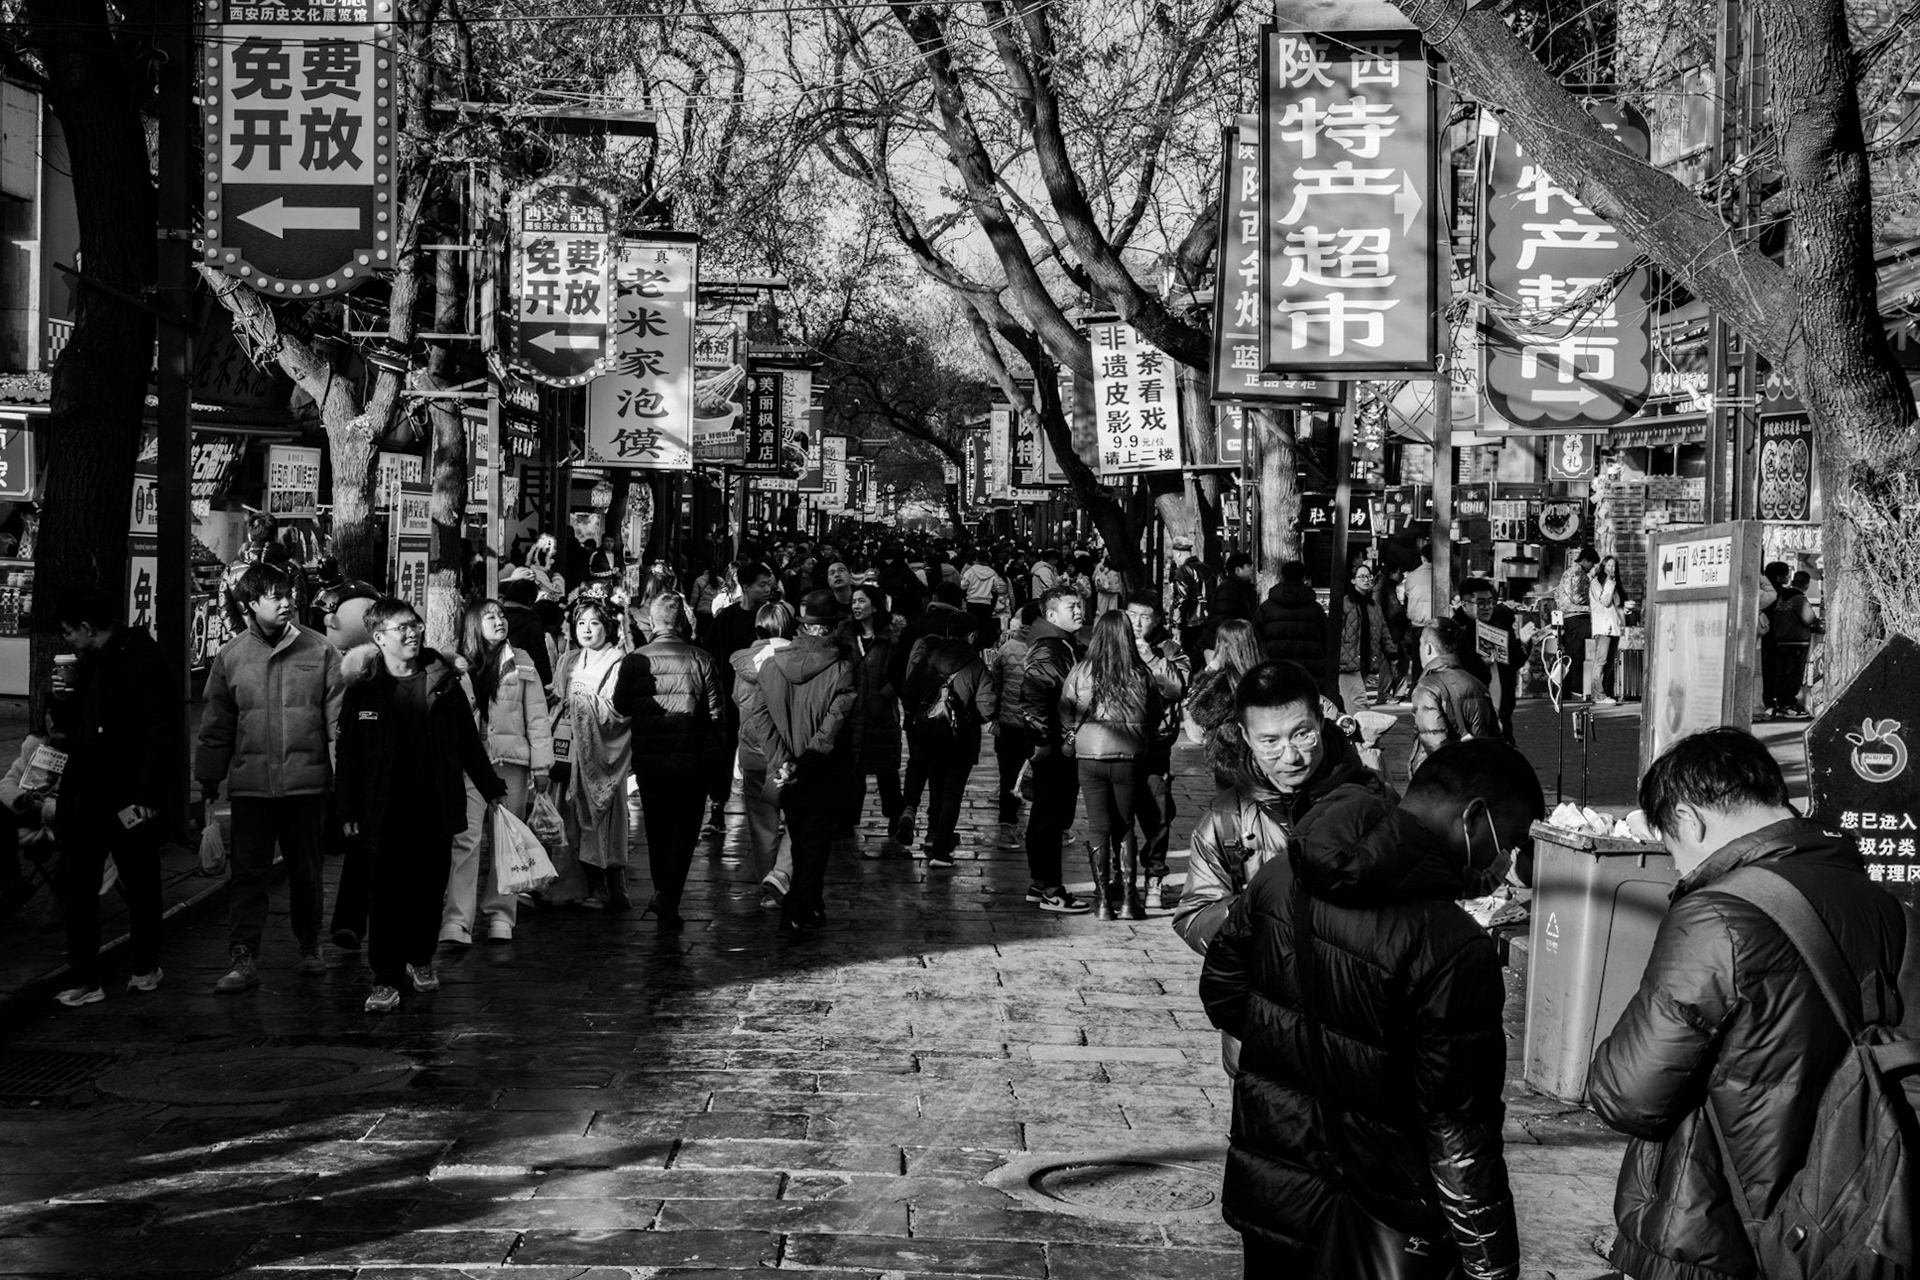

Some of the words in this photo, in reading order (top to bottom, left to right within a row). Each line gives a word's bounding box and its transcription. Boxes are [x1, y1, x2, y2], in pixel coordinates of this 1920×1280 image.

[229, 6, 368, 22] 西安历史文化展览馆
[231, 37, 361, 102] 免费
[1278, 37, 1400, 90] 陕西
[230, 107, 363, 172] 开放
[1277, 97, 1400, 358] 特产超市
[526, 239, 602, 277] 免费
[525, 280, 601, 316] 开放
[610, 268, 670, 459] 老米家泡馍
[1100, 326, 1132, 433] 非遗皮影
[1135, 331, 1167, 431] 茶看戏
[1105, 447, 1174, 465] 请上二楼
[1113, 435, 1138, 448] 9.9
[1309, 506, 1366, 527] 肚肉
[1701, 568, 1718, 582] Toilet
[1840, 810, 1917, 830] 您已进入
[1856, 837, 1916, 857] 圾分类
[1864, 864, 1920, 883] 管理区
